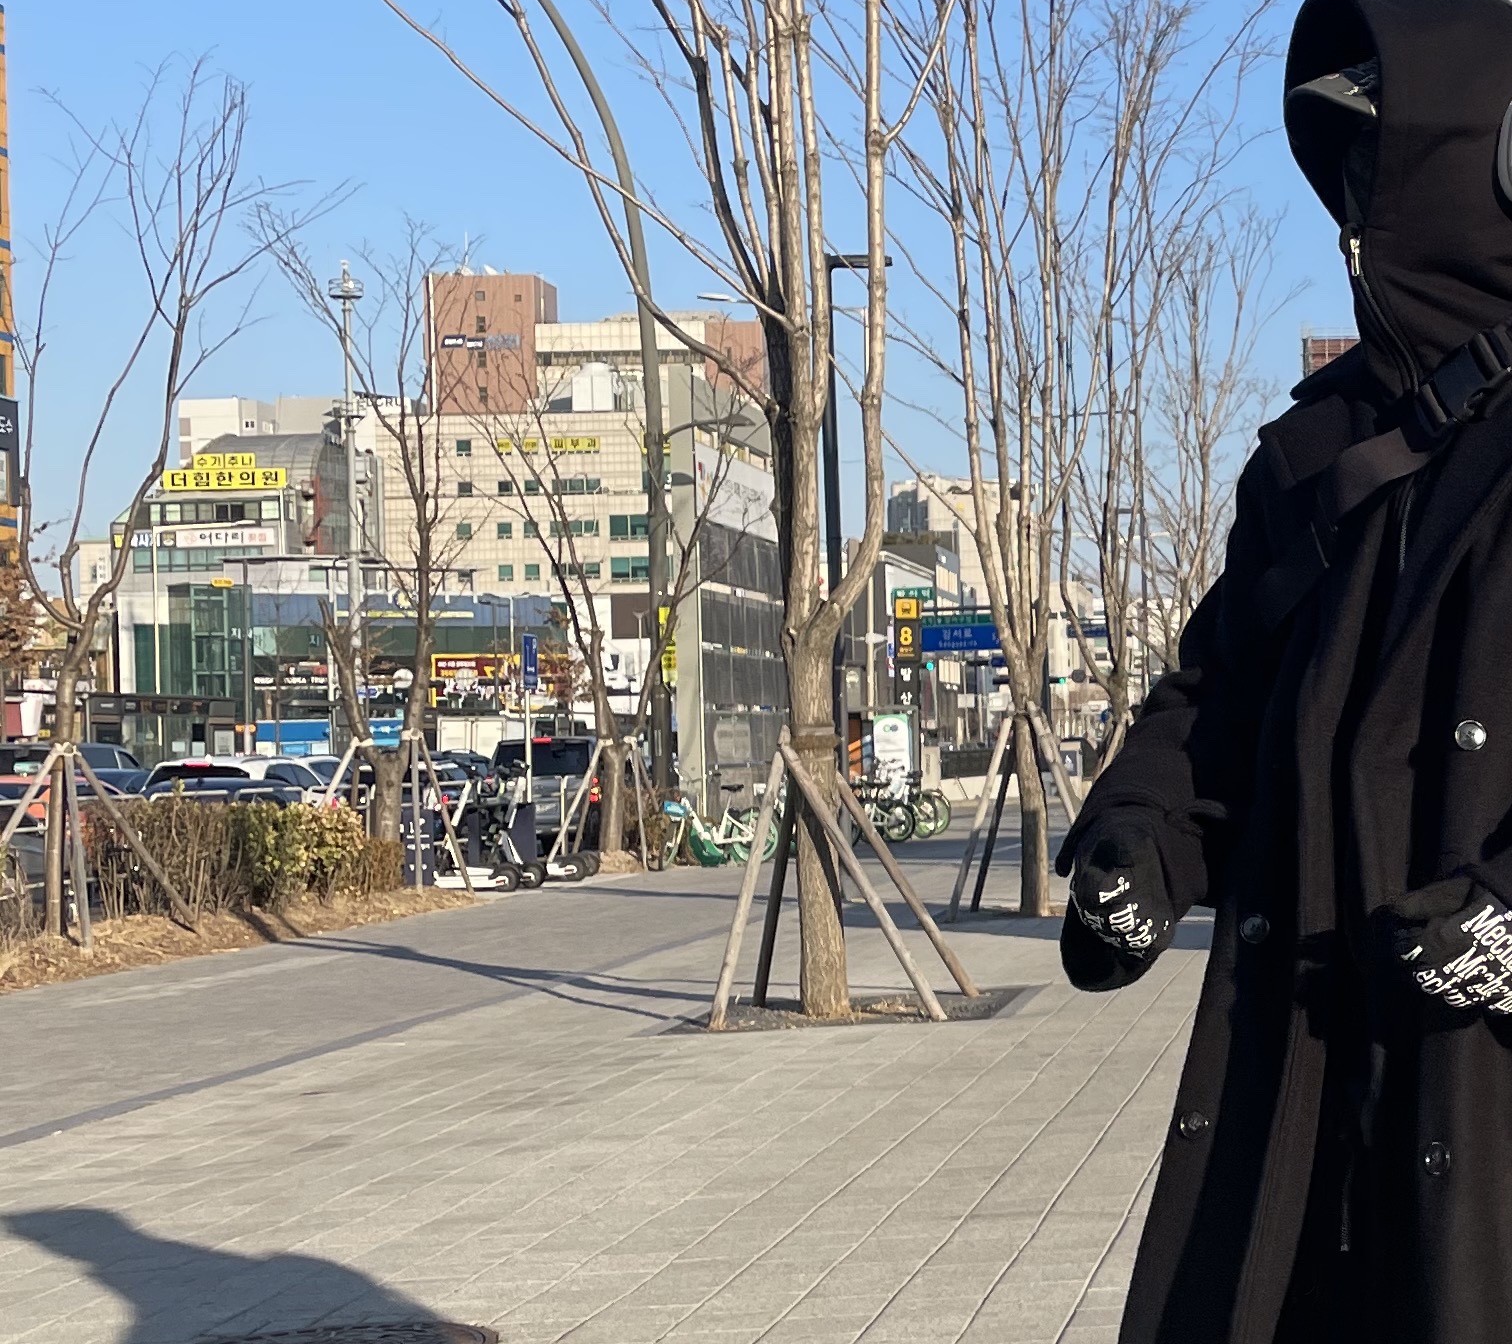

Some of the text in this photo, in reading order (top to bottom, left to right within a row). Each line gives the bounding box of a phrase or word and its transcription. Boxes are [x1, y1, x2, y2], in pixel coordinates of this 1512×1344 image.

[554, 438, 596, 449] 피부과
[196, 455, 253, 467] 수기 추나
[900, 626, 913, 646] 8
[900, 667, 913, 706] 발산
